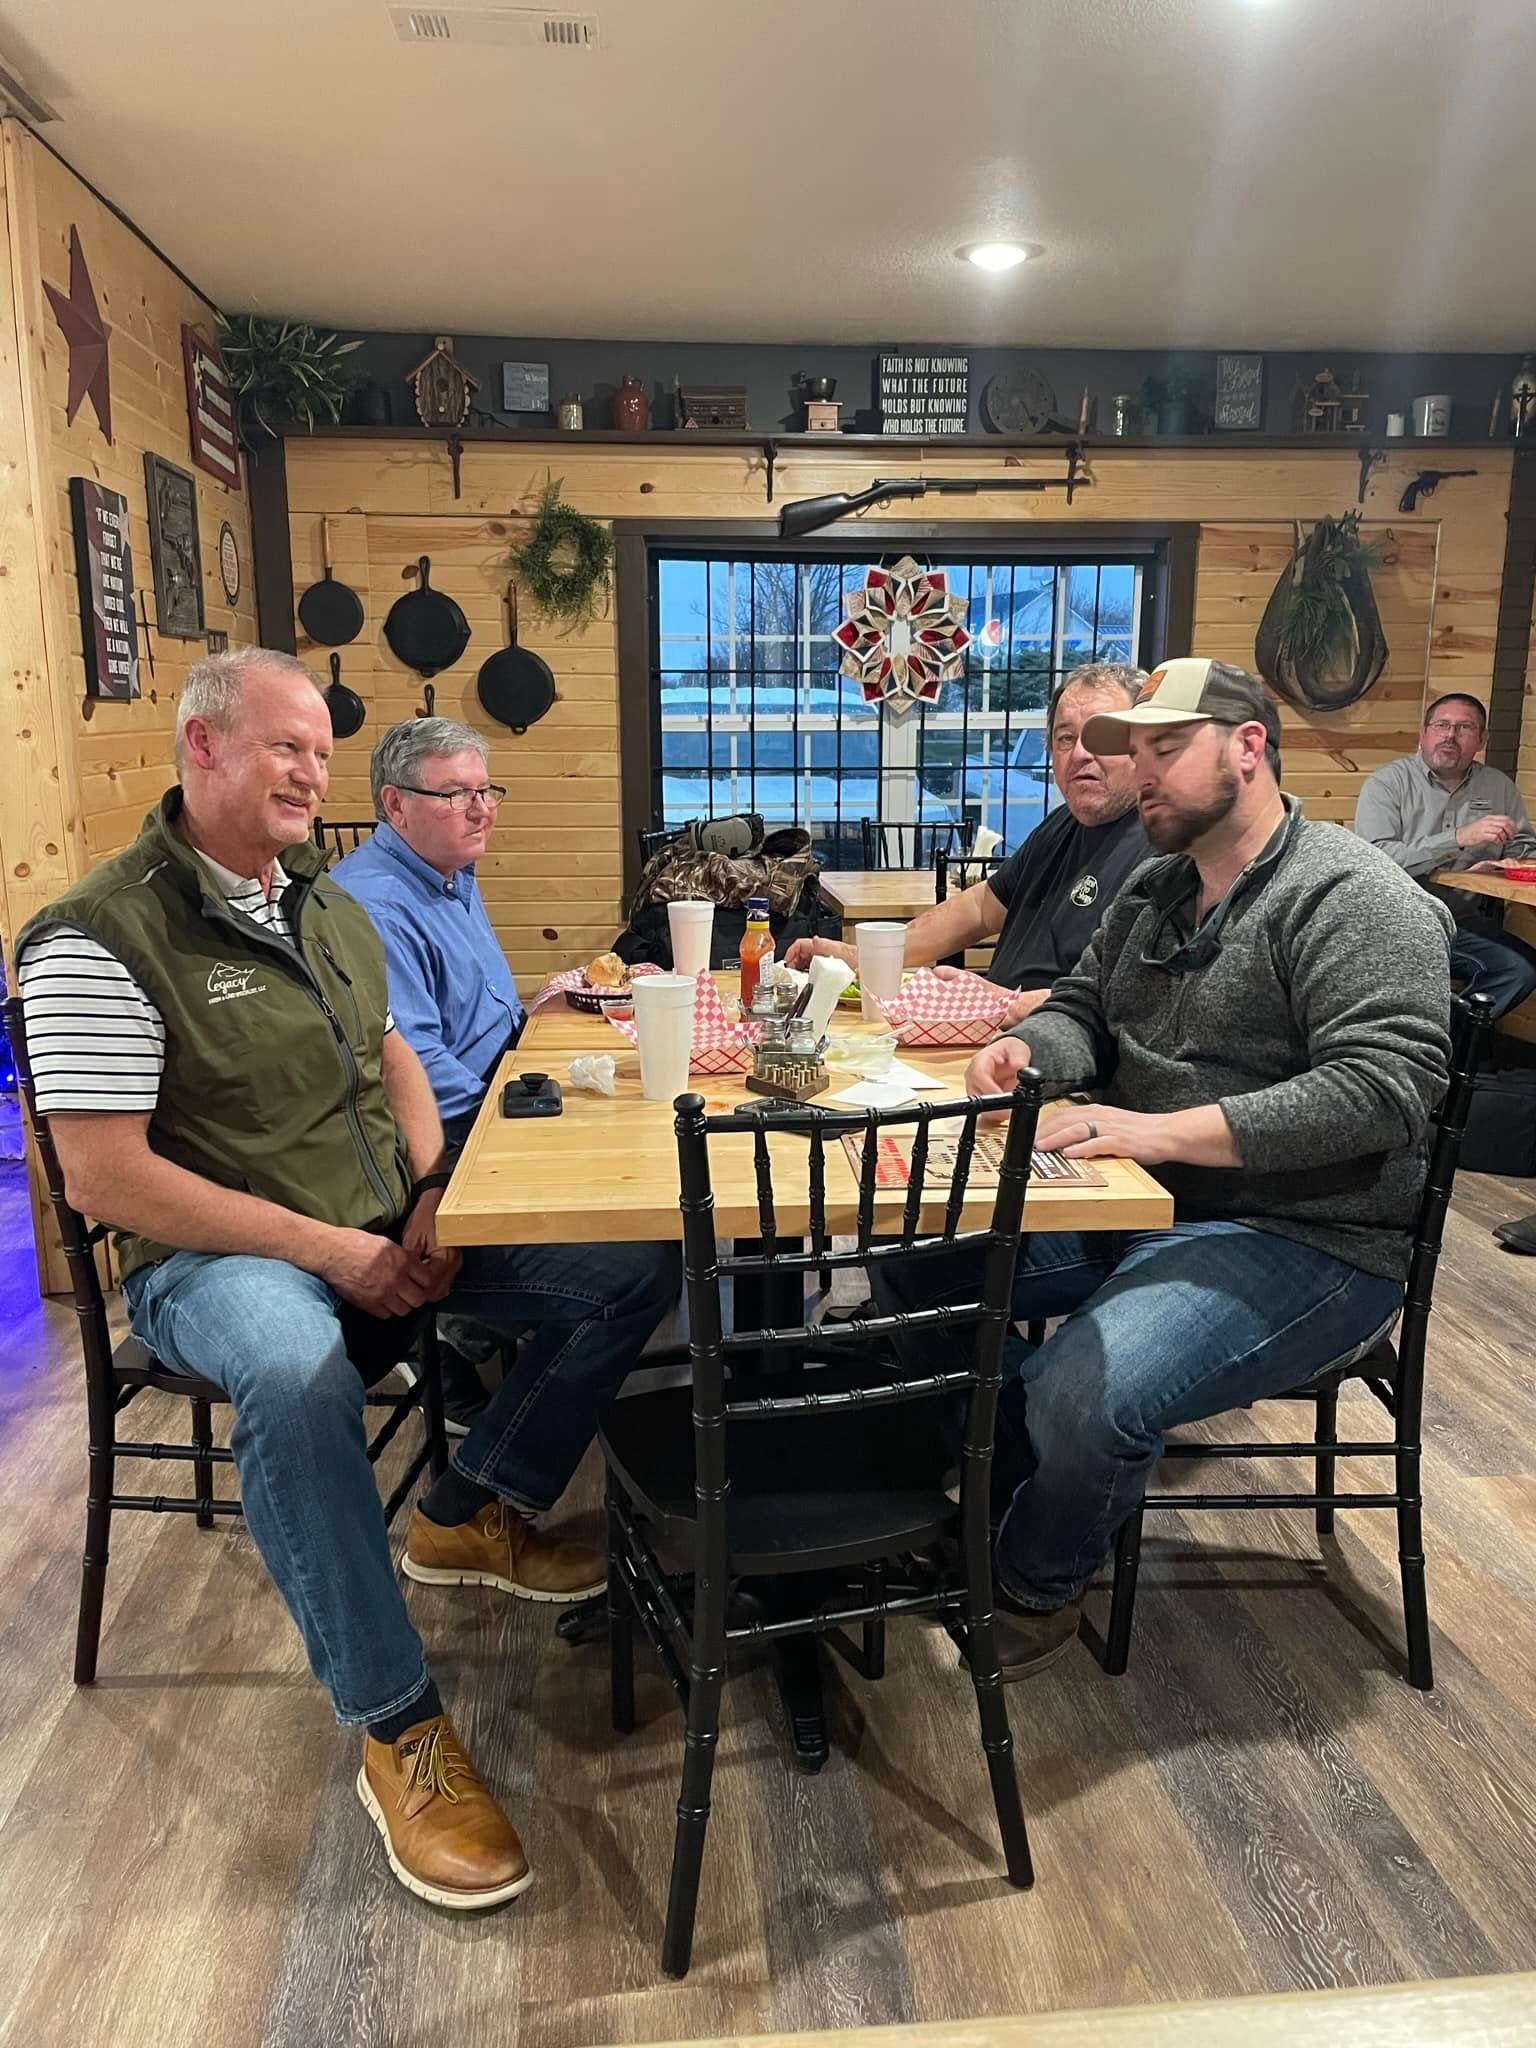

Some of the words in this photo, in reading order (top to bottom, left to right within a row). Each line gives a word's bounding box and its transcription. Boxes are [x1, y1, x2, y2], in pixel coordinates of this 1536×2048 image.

[883, 358, 903, 373] FAITH
[905, 358, 913, 373] IS
[915, 358, 929, 373] NOT
[931, 358, 968, 373] KNOWING
[882, 378, 908, 393] WHAT
[912, 378, 928, 393] THE
[933, 378, 967, 393] FUTURE
[882, 398, 908, 413] HOLDS
[910, 398, 925, 413] BUT
[928, 398, 967, 413] KNOWING
[883, 419, 899, 434] WHO
[901, 419, 923, 434] HOLDS
[925, 418, 937, 433] THE
[207, 972, 252, 994] Legacy
